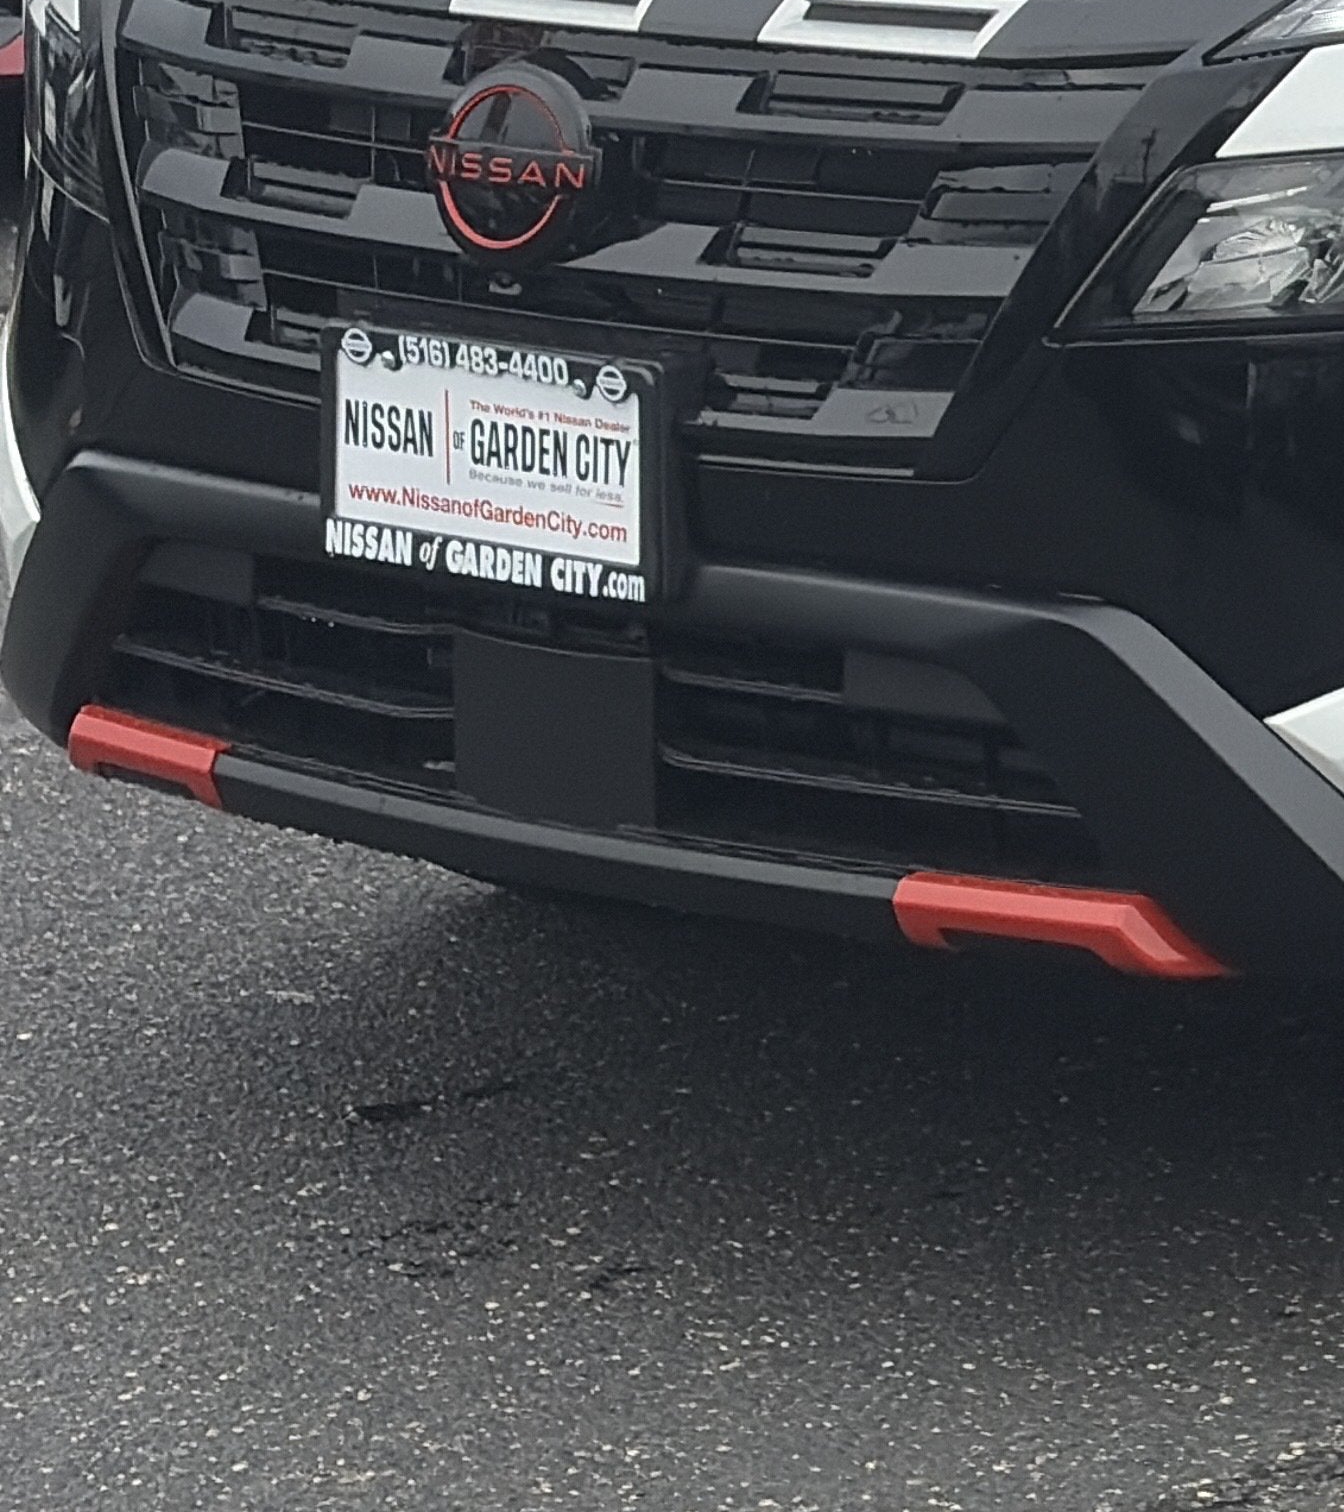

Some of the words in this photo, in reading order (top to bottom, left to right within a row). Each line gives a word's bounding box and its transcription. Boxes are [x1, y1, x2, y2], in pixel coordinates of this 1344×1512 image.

[428, 145, 585, 188] NISSAN
[399, 335, 450, 367] (516)
[456, 344, 569, 386] 483-4400
[469, 399, 491, 413] The
[493, 403, 535, 420] World's
[538, 410, 550, 422] #1
[554, 412, 592, 428] Nissan
[595, 418, 631, 434] Dealer
[344, 399, 434, 457] NISSAN
[453, 430, 466, 450] OF
[470, 418, 568, 478] GARDEN
[576, 433, 632, 487] CITY
[469, 468, 523, 487] Because
[527, 479, 546, 490] we
[550, 480, 572, 494] sell
[575, 486, 593, 498] for
[348, 484, 628, 543] www.NissanofGardenCity.com
[325, 519, 413, 567] NISSAN
[418, 536, 443, 570] of
[445, 540, 543, 588] GARDEN
[550, 557, 646, 602] CITY.com
